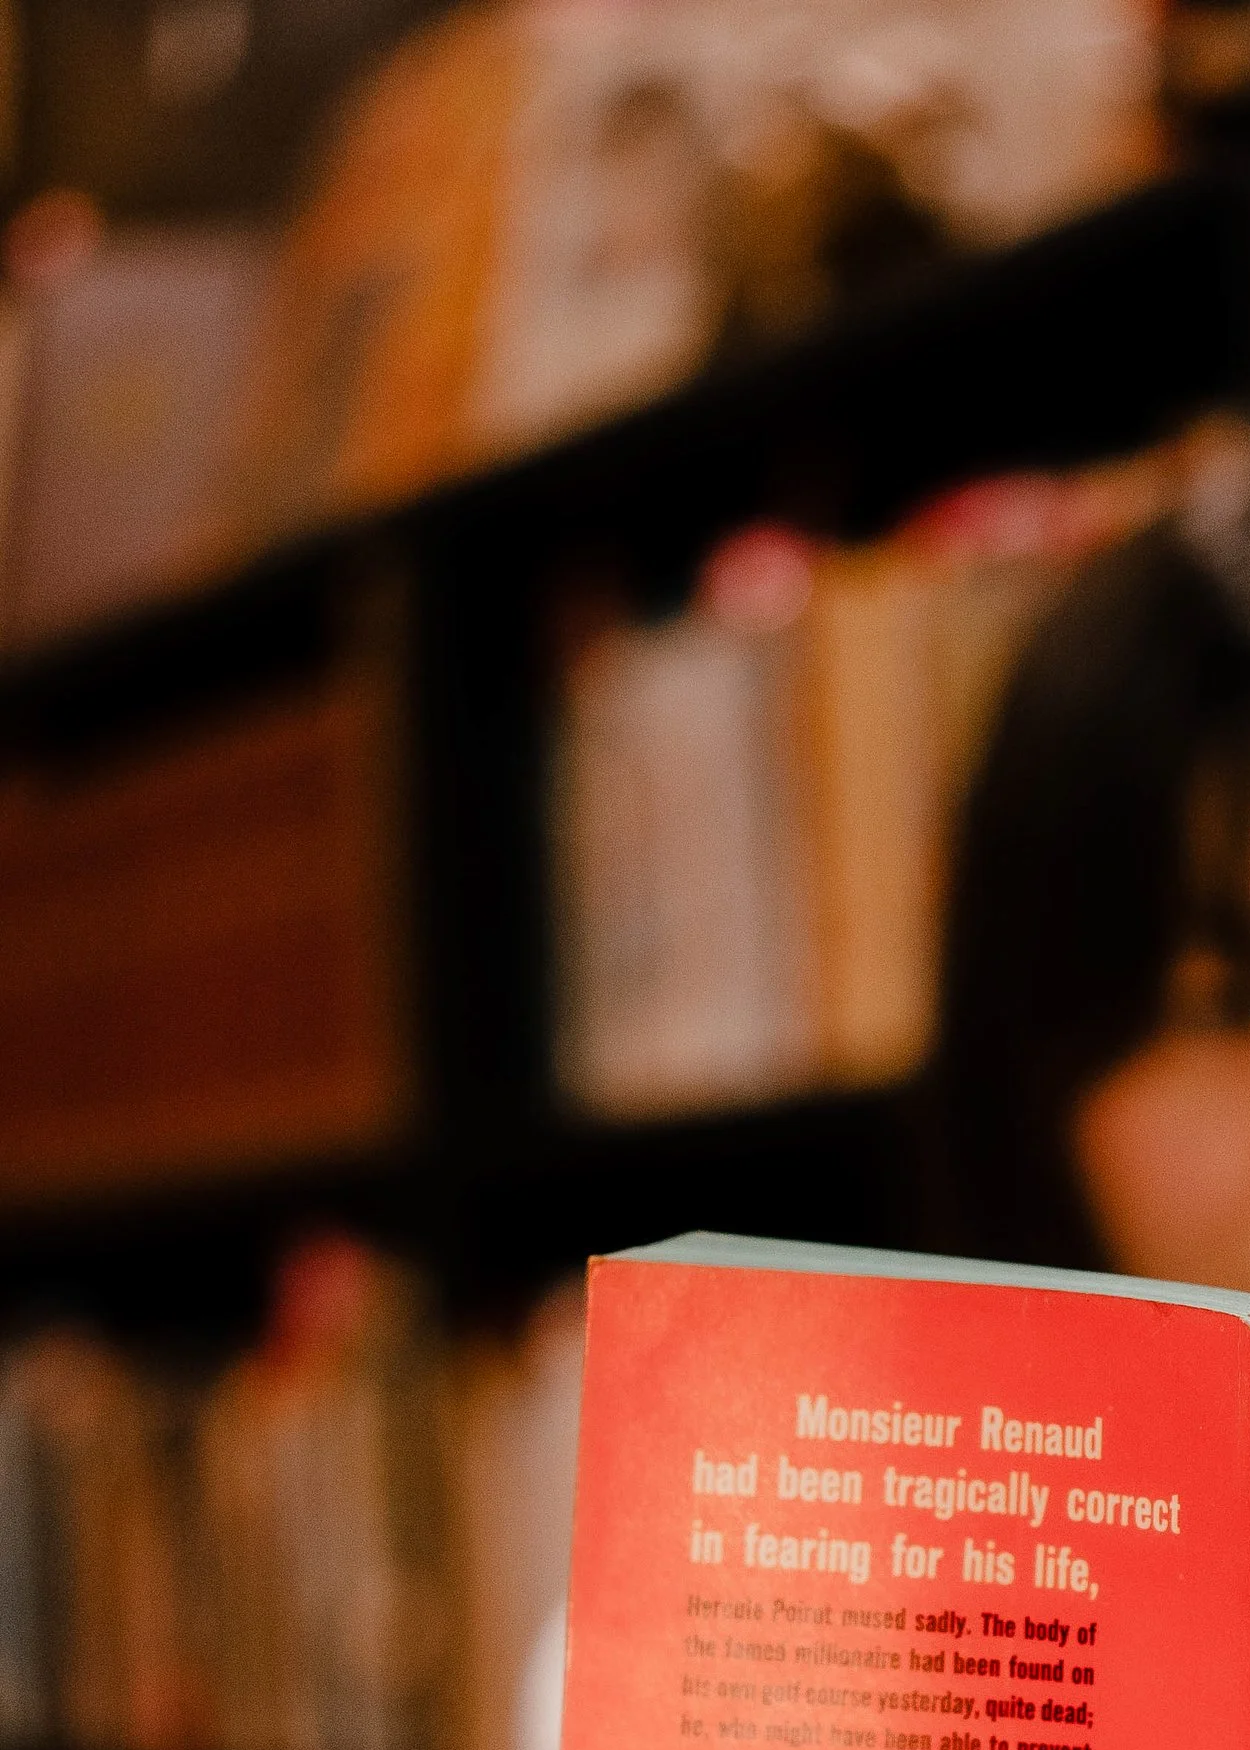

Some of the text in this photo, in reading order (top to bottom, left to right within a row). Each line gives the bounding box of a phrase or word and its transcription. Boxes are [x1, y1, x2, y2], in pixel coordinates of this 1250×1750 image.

[796, 1393, 1103, 1461] Monsieur Renaud
[692, 1448, 1181, 1535] had been tragically correct
[690, 1519, 1099, 1601] in fearing for his life,
[841, 1608, 906, 1630] mused
[915, 1610, 972, 1637] sadly.
[981, 1611, 1016, 1638] The
[1023, 1617, 1070, 1646] body
[1076, 1621, 1097, 1645] of
[909, 1649, 945, 1673] had
[953, 1651, 1001, 1676] been
[1008, 1655, 1064, 1682] found
[1071, 1666, 1095, 1685] on
[878, 1691, 980, 1718] yesterday,
[985, 1696, 1036, 1721] quite
[1040, 1699, 1093, 1726] dead;
[883, 1730, 931, 1750] been
